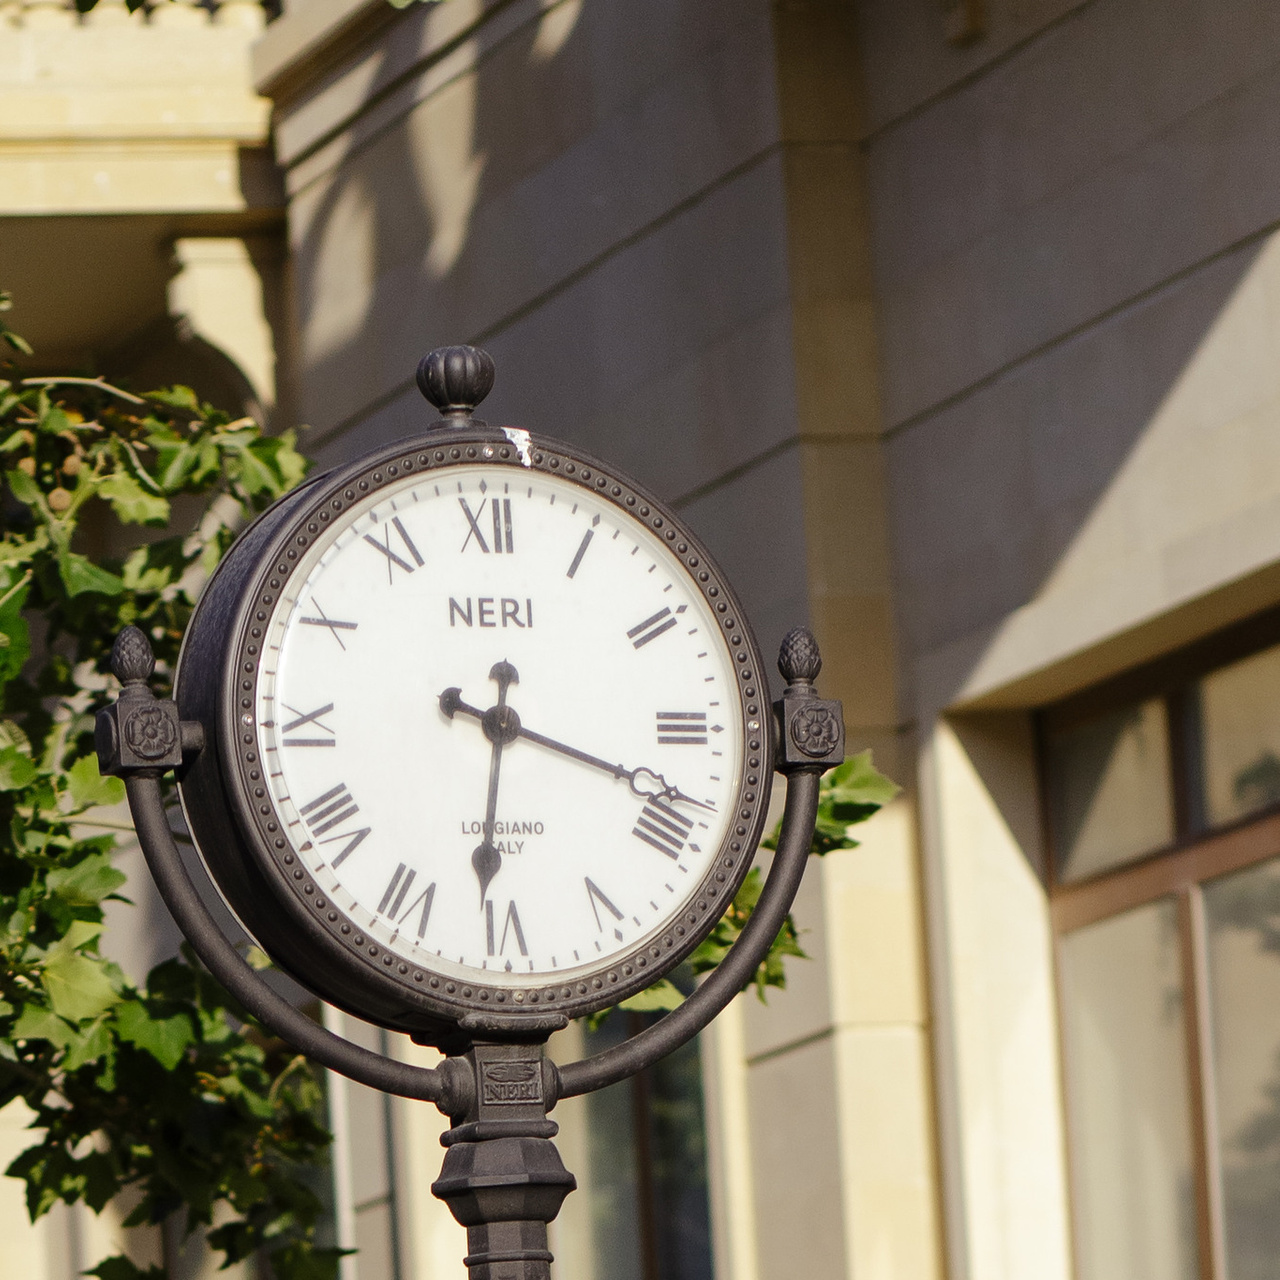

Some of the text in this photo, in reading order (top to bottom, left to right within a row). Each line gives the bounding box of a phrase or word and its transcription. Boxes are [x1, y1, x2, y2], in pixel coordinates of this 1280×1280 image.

[363, 516, 425, 585] XI
[459, 497, 514, 554] XII
[299, 596, 358, 650] X
[448, 597, 533, 628] NERI
[626, 606, 678, 650] II
[281, 703, 336, 747] IX
[656, 712, 708, 745] III
[299, 782, 372, 870] VIII
[481, 840, 525, 854] ALY
[376, 862, 437, 939] VII
[584, 876, 625, 933] V
[485, 900, 529, 956] VI
[484, 1083, 540, 1101] NERI
